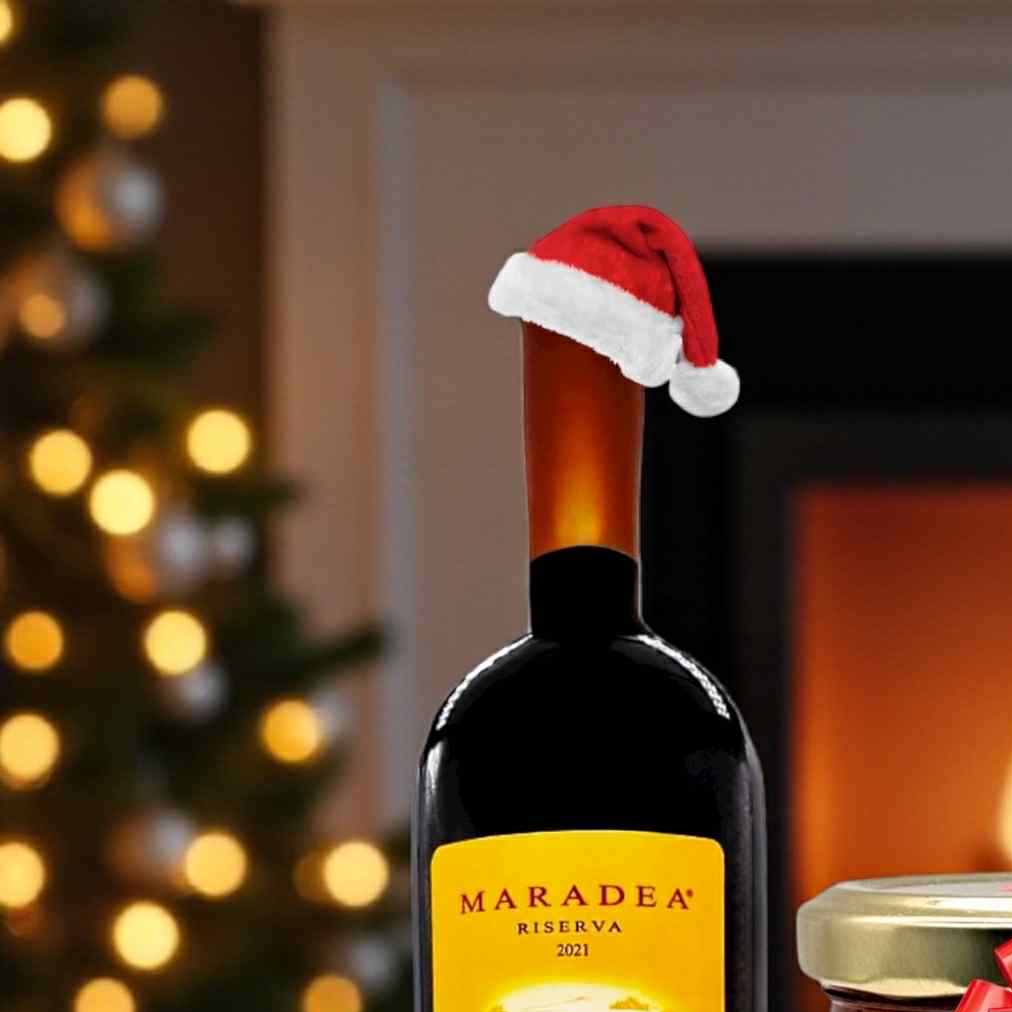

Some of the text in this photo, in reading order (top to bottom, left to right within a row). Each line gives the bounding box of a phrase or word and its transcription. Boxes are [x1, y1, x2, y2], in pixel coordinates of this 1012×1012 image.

[460, 884, 689, 914] MARADEA
[517, 921, 622, 935] RISERVA
[557, 943, 589, 957] 2021
